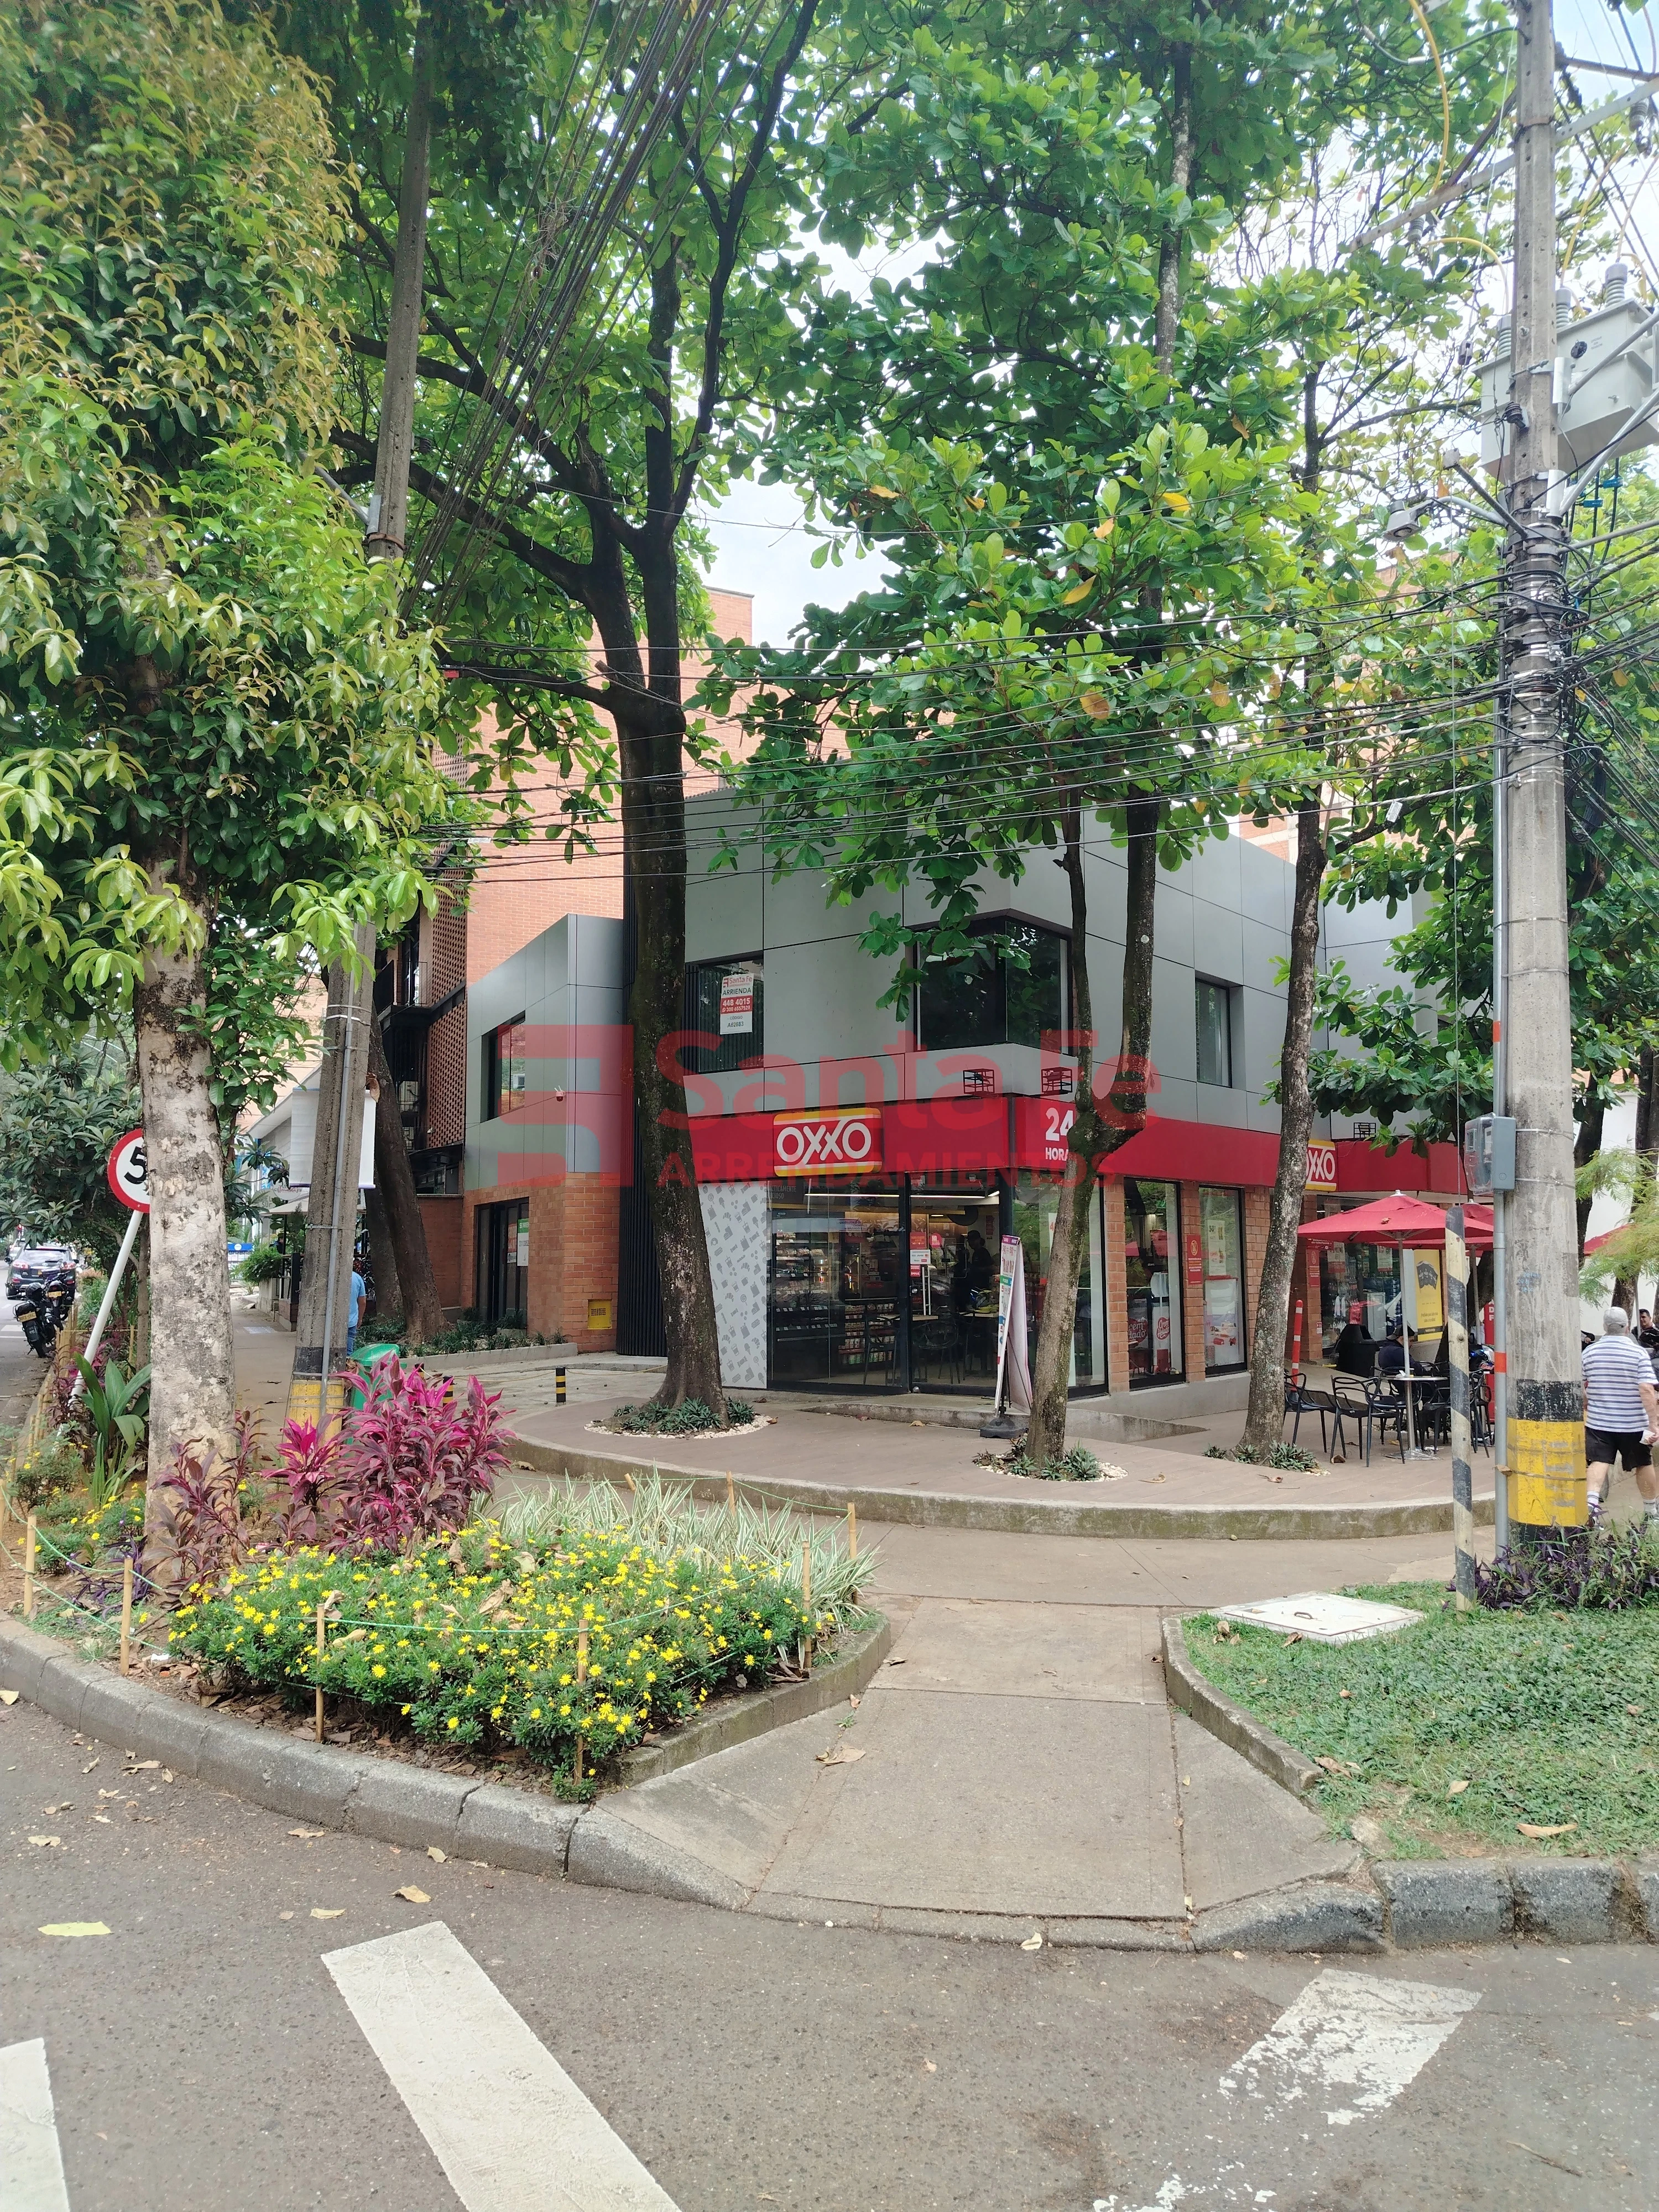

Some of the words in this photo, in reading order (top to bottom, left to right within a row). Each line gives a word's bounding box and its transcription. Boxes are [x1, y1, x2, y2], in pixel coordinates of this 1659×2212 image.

[1045, 1107, 1073, 1141] 24
[776, 1118, 872, 1165] OXXO
[1129, 1322, 1144, 1331] rem
